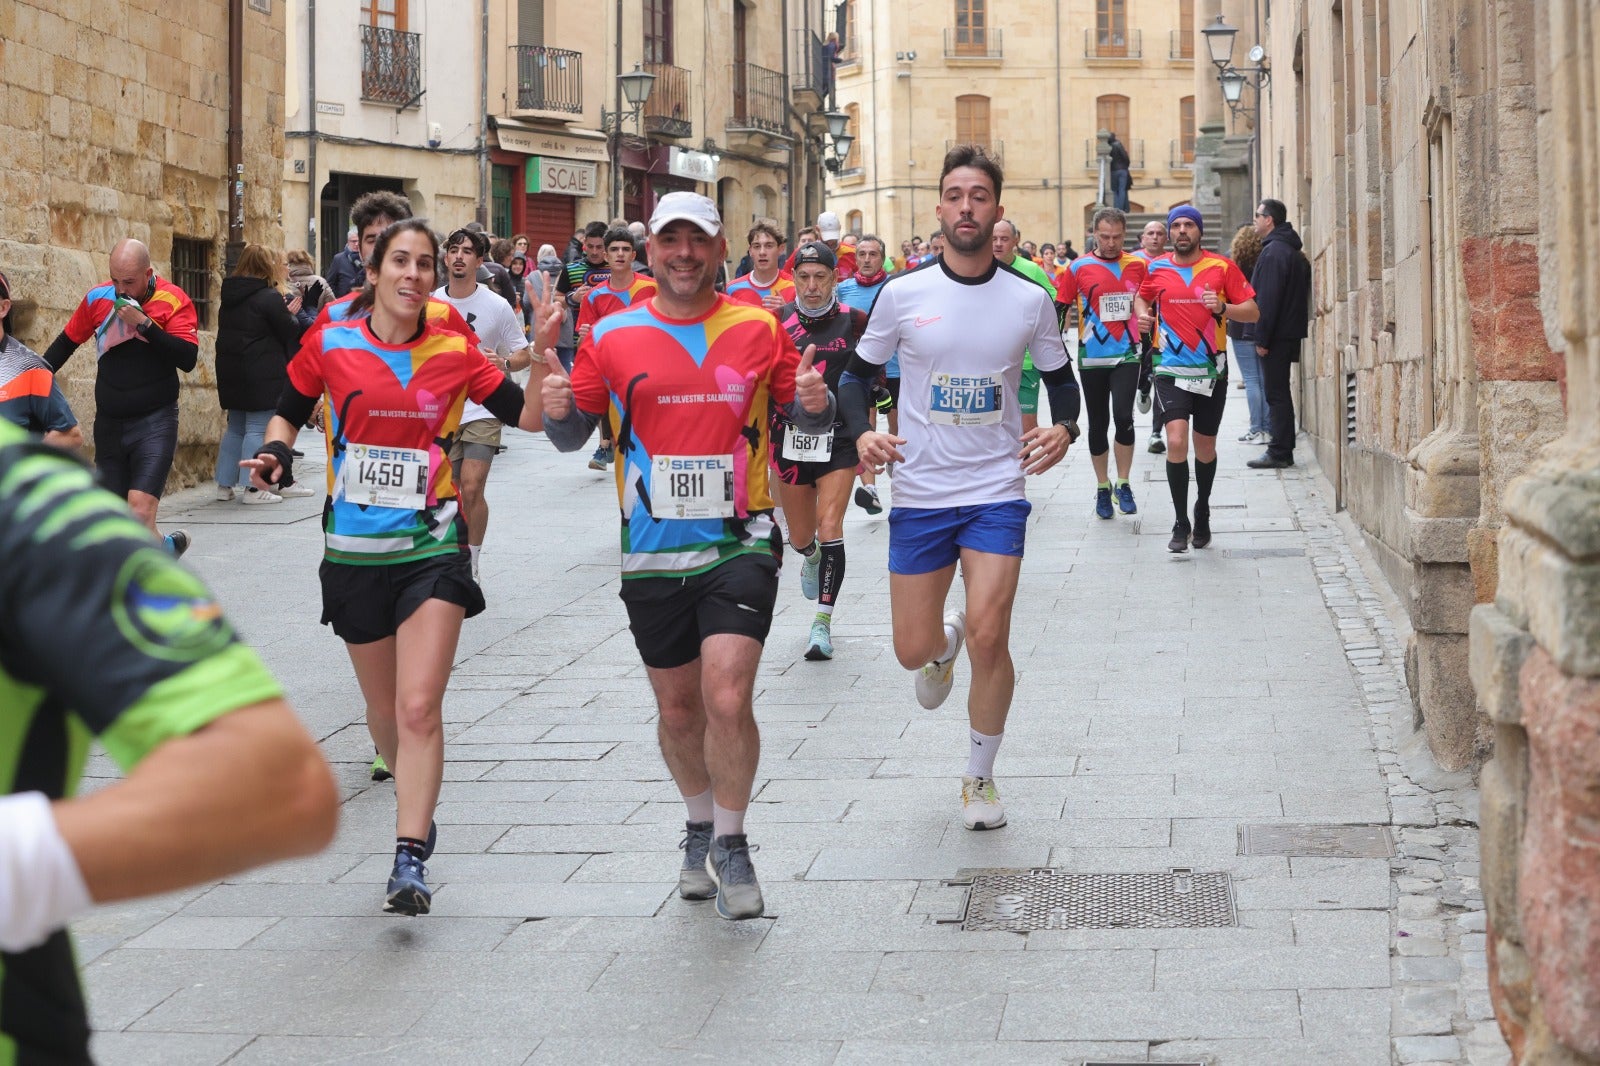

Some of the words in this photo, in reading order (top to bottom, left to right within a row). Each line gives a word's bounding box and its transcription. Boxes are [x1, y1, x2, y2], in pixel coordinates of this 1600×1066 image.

[514, 138, 531, 148] away
[548, 167, 587, 191] SCALE
[1105, 301, 1125, 313] 1894
[950, 377, 996, 387] SETEL
[657, 395, 671, 404] SAN
[672, 394, 705, 404] SILVESTRE
[940, 387, 985, 409] 3676
[368, 409, 380, 417] SAN
[380, 410, 408, 418] SILVESTRE
[792, 435, 819, 450] 1587
[368, 449, 421, 463] SETEL
[671, 459, 726, 470] SETEL
[359, 461, 404, 487] 1459
[670, 473, 703, 497] 1811
